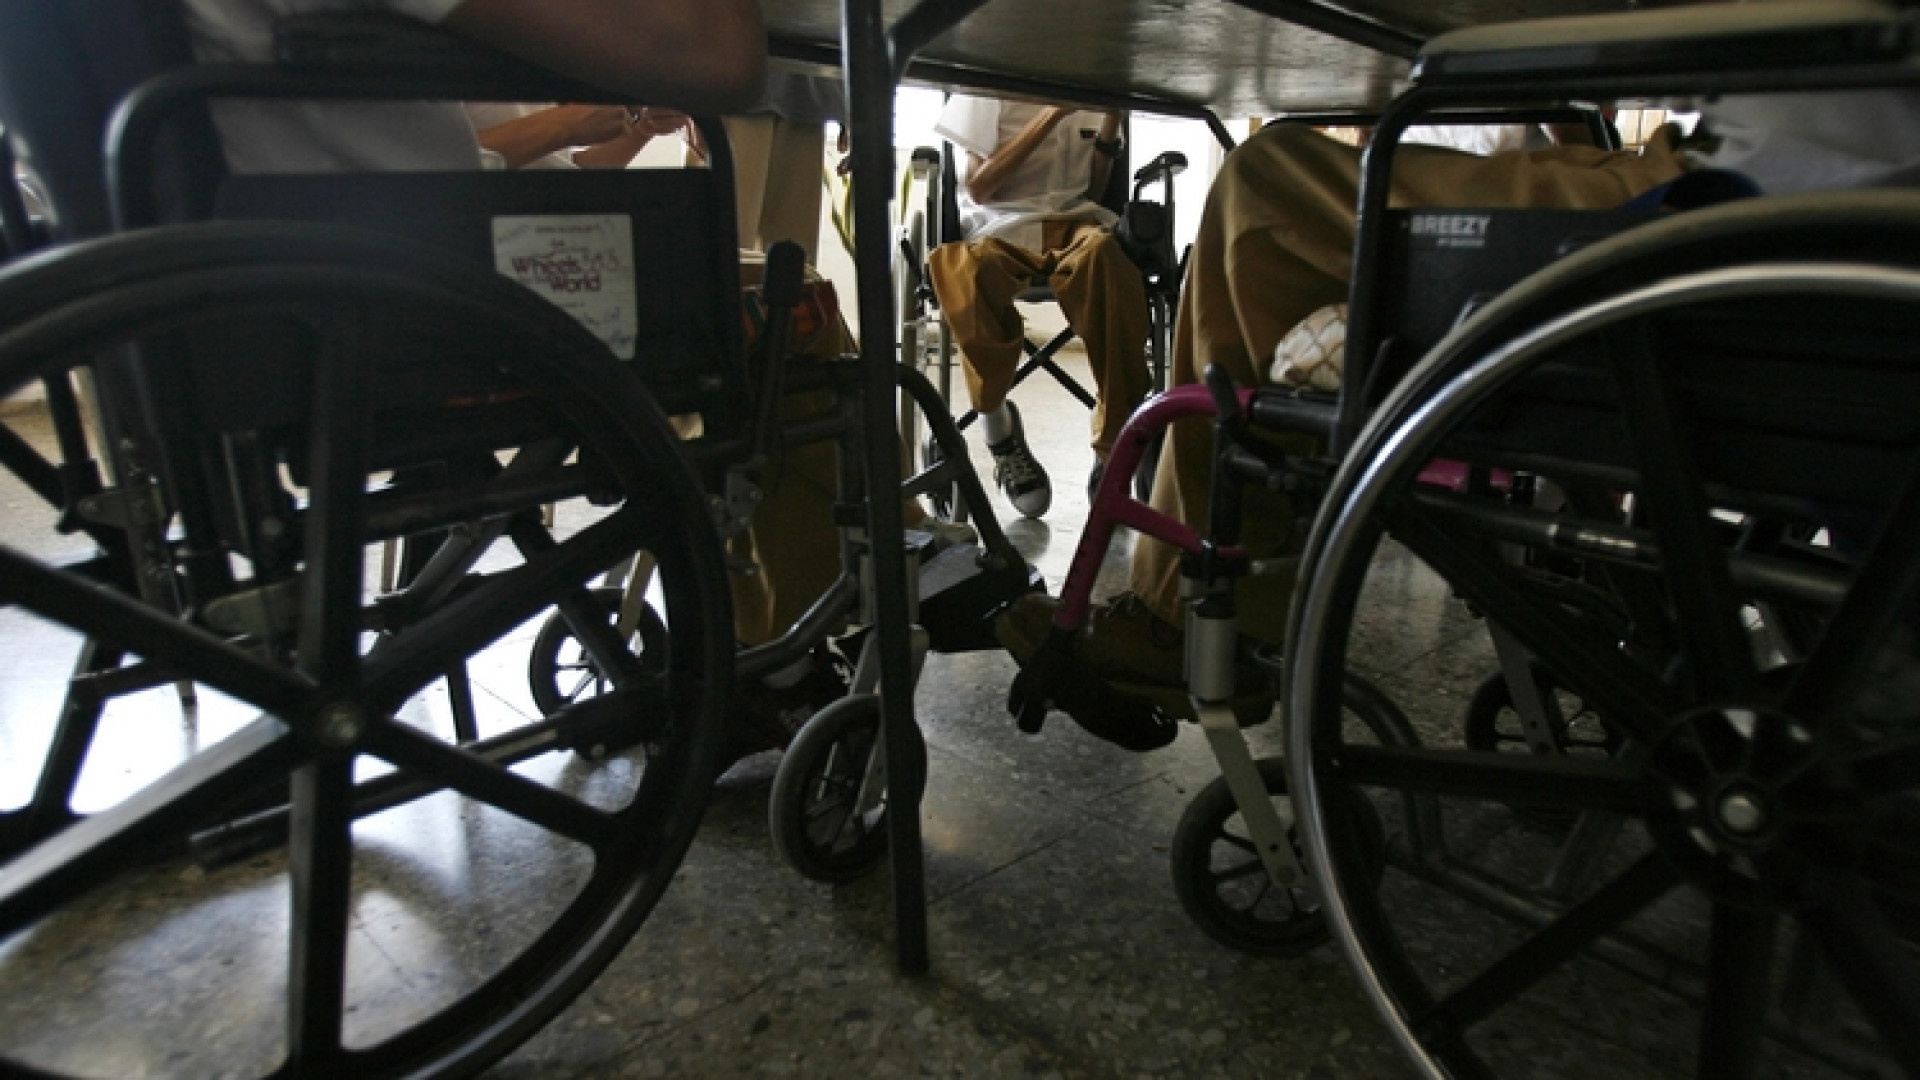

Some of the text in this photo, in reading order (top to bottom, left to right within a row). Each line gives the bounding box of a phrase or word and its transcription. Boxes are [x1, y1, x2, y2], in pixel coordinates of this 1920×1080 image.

[1411, 214, 1491, 234] BREEZY
[511, 255, 582, 275] Wheels
[551, 273, 602, 294] World
